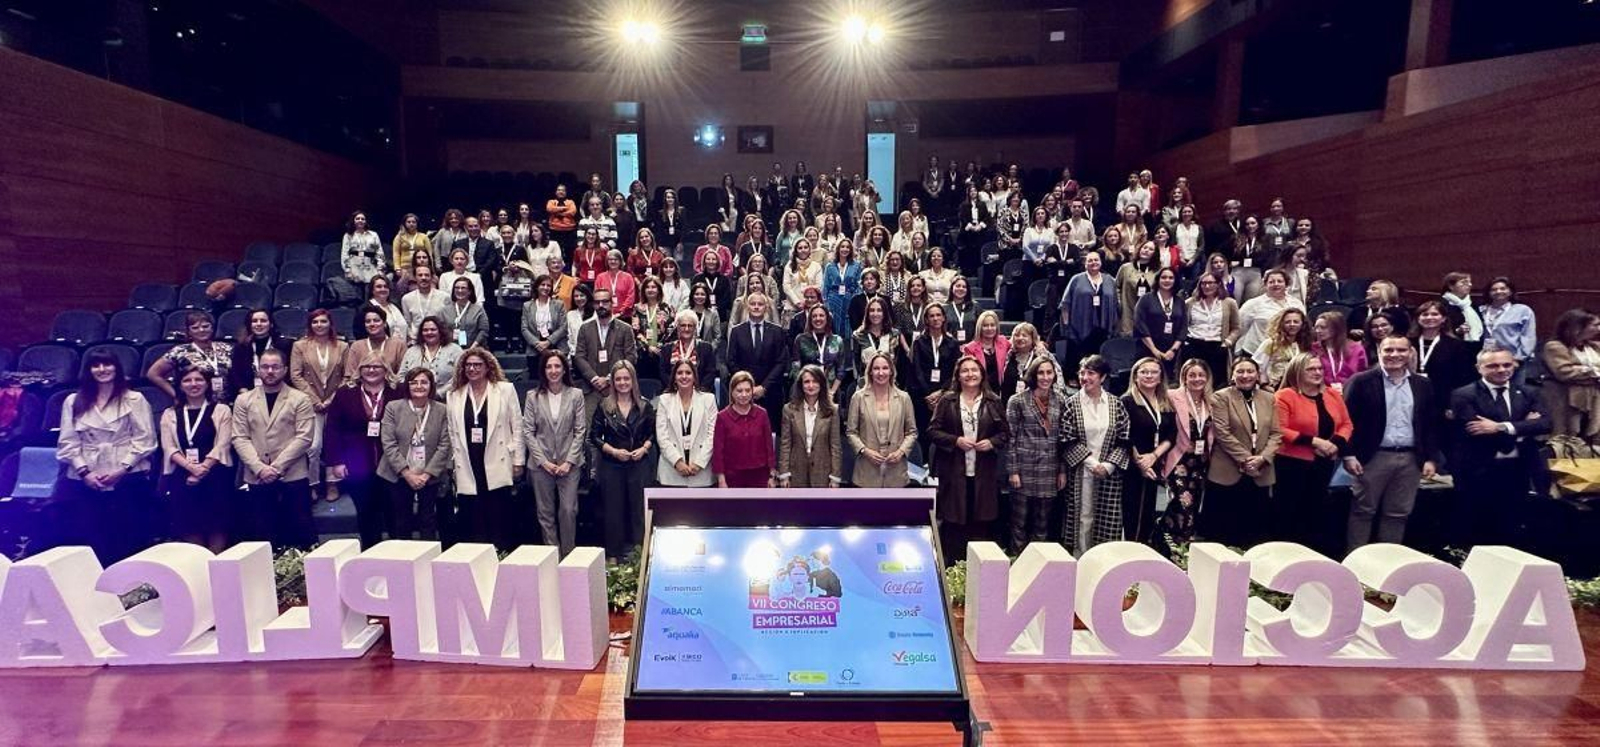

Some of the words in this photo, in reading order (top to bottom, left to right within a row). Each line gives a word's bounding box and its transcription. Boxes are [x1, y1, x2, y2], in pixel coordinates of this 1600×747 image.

[752, 598, 766, 609] VII
[769, 599, 837, 611] CONGRESO
[756, 614, 835, 627] EMPRESARIAL
[892, 650, 937, 665] Vegalsa
